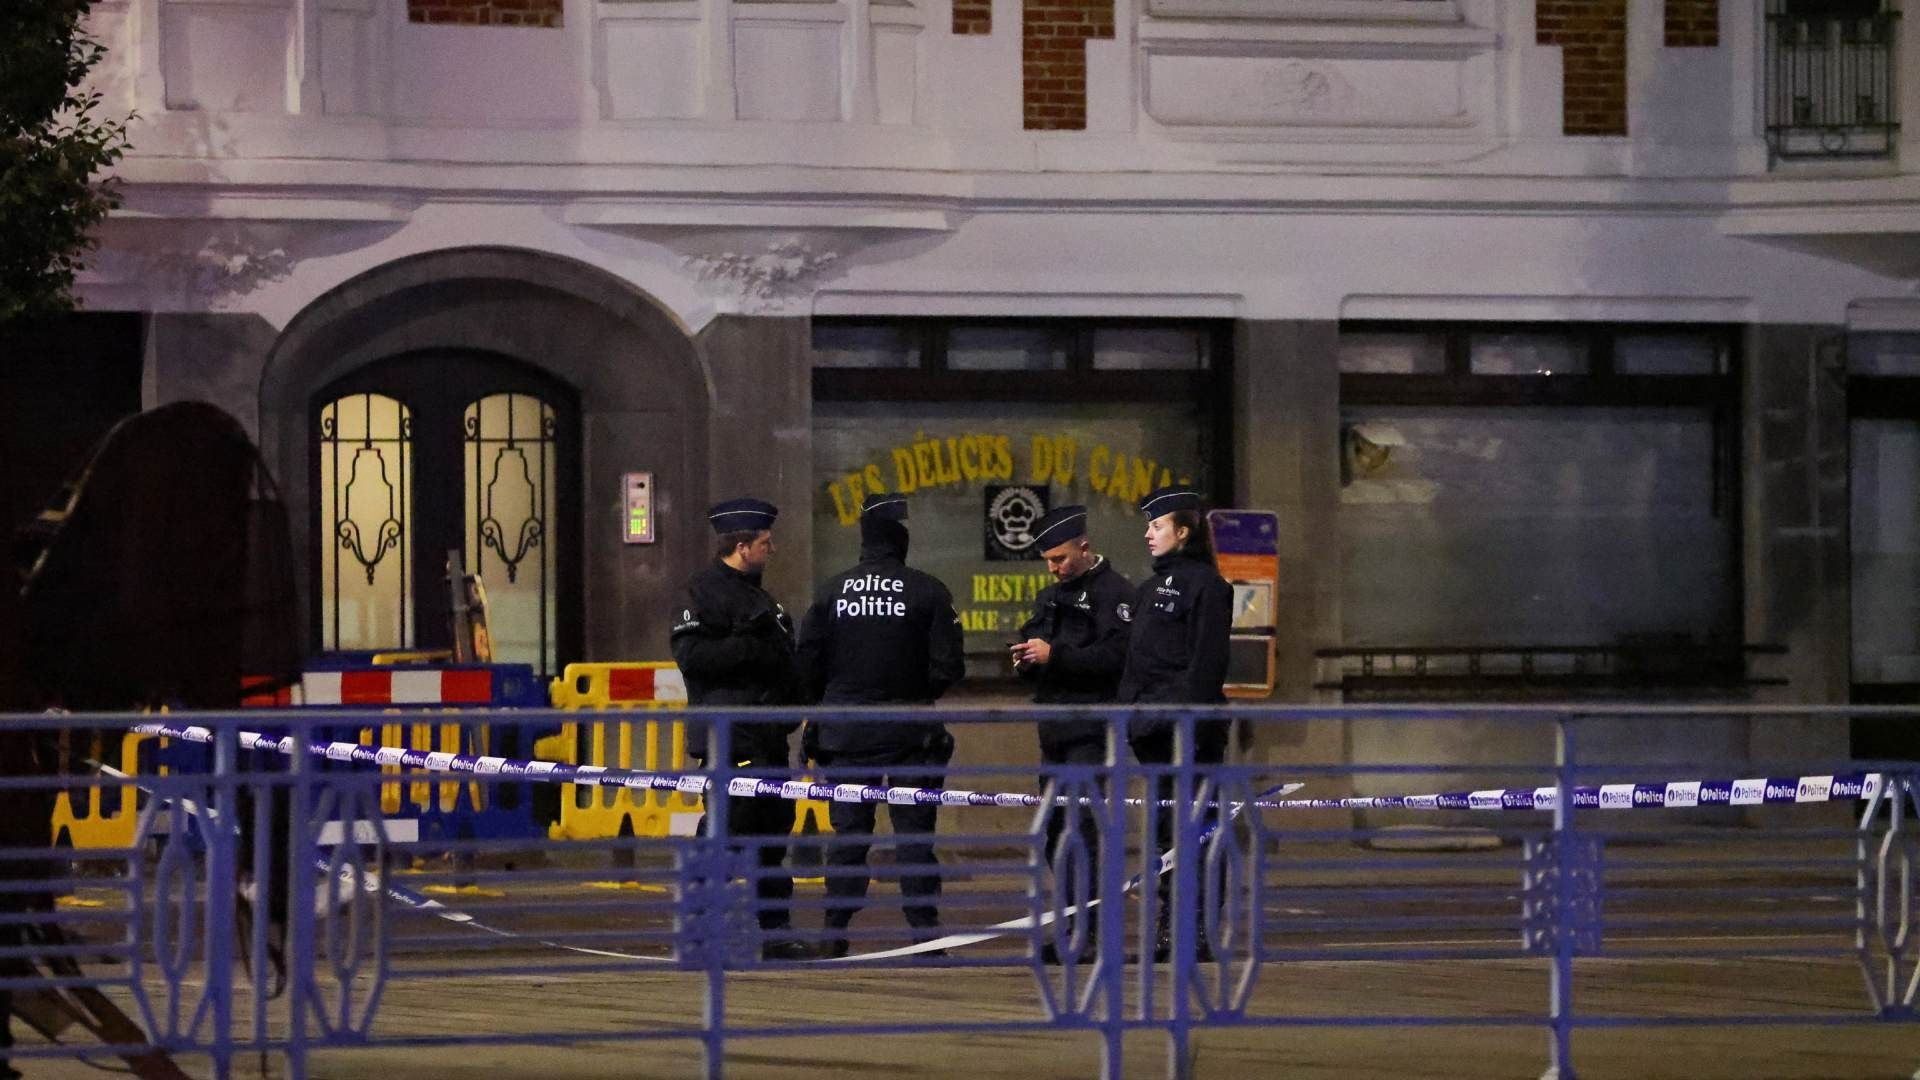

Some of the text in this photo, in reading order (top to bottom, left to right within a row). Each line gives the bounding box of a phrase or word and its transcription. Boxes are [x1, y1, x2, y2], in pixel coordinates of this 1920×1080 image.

[892, 427, 1013, 494] DÉLICES
[1031, 434, 1077, 486] DU
[842, 574, 904, 594] Police
[836, 595, 906, 618] Politie
[407, 754, 424, 766] Police
[457, 759, 474, 771] Police
[658, 777, 677, 787] Police
[737, 782, 755, 793] Politie
[763, 783, 781, 794] Police
[816, 786, 833, 798] Police
[868, 789, 887, 800] Police
[1511, 795, 1533, 807] Police
[1576, 793, 1598, 805] Police
[1609, 792, 1631, 804] Politie
[1642, 791, 1664, 803] Police
[1675, 789, 1697, 802] Politie
[1708, 787, 1730, 801] Police
[1741, 787, 1763, 800] Politie
[1773, 784, 1796, 799] Police
[1807, 783, 1828, 796] Politie
[1839, 782, 1861, 796] Police
